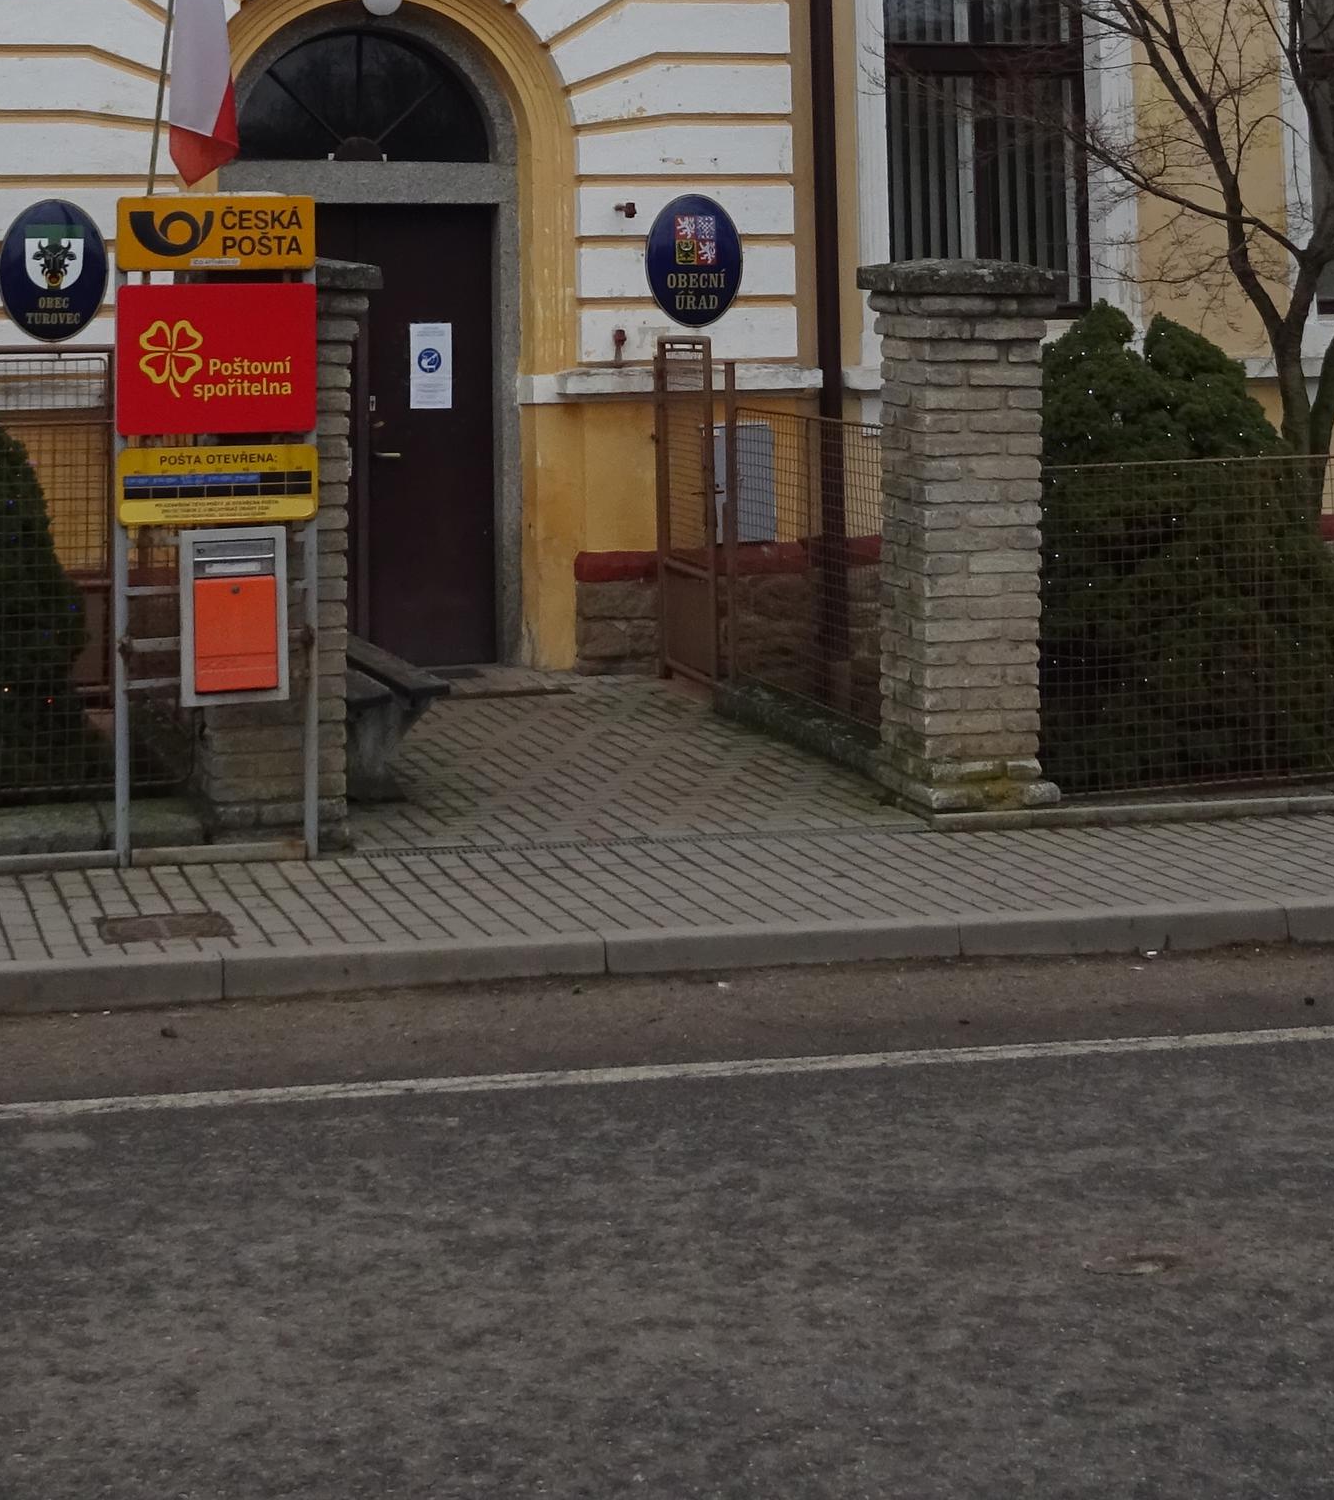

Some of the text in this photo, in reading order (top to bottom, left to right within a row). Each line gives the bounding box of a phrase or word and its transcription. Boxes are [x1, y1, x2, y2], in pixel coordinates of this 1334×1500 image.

[221, 206, 302, 230] ČESKÁ
[222, 231, 302, 256] POŠTA
[667, 269, 725, 288] OBECNÍ
[38, 297, 70, 309] OBEC
[675, 290, 719, 310] ÚŘAD
[26, 313, 81, 325] TUROVEC
[209, 356, 291, 376] Poštovní
[193, 378, 292, 401] spořitelna
[160, 451, 277, 465] POŠTA OTEVŘENA:
